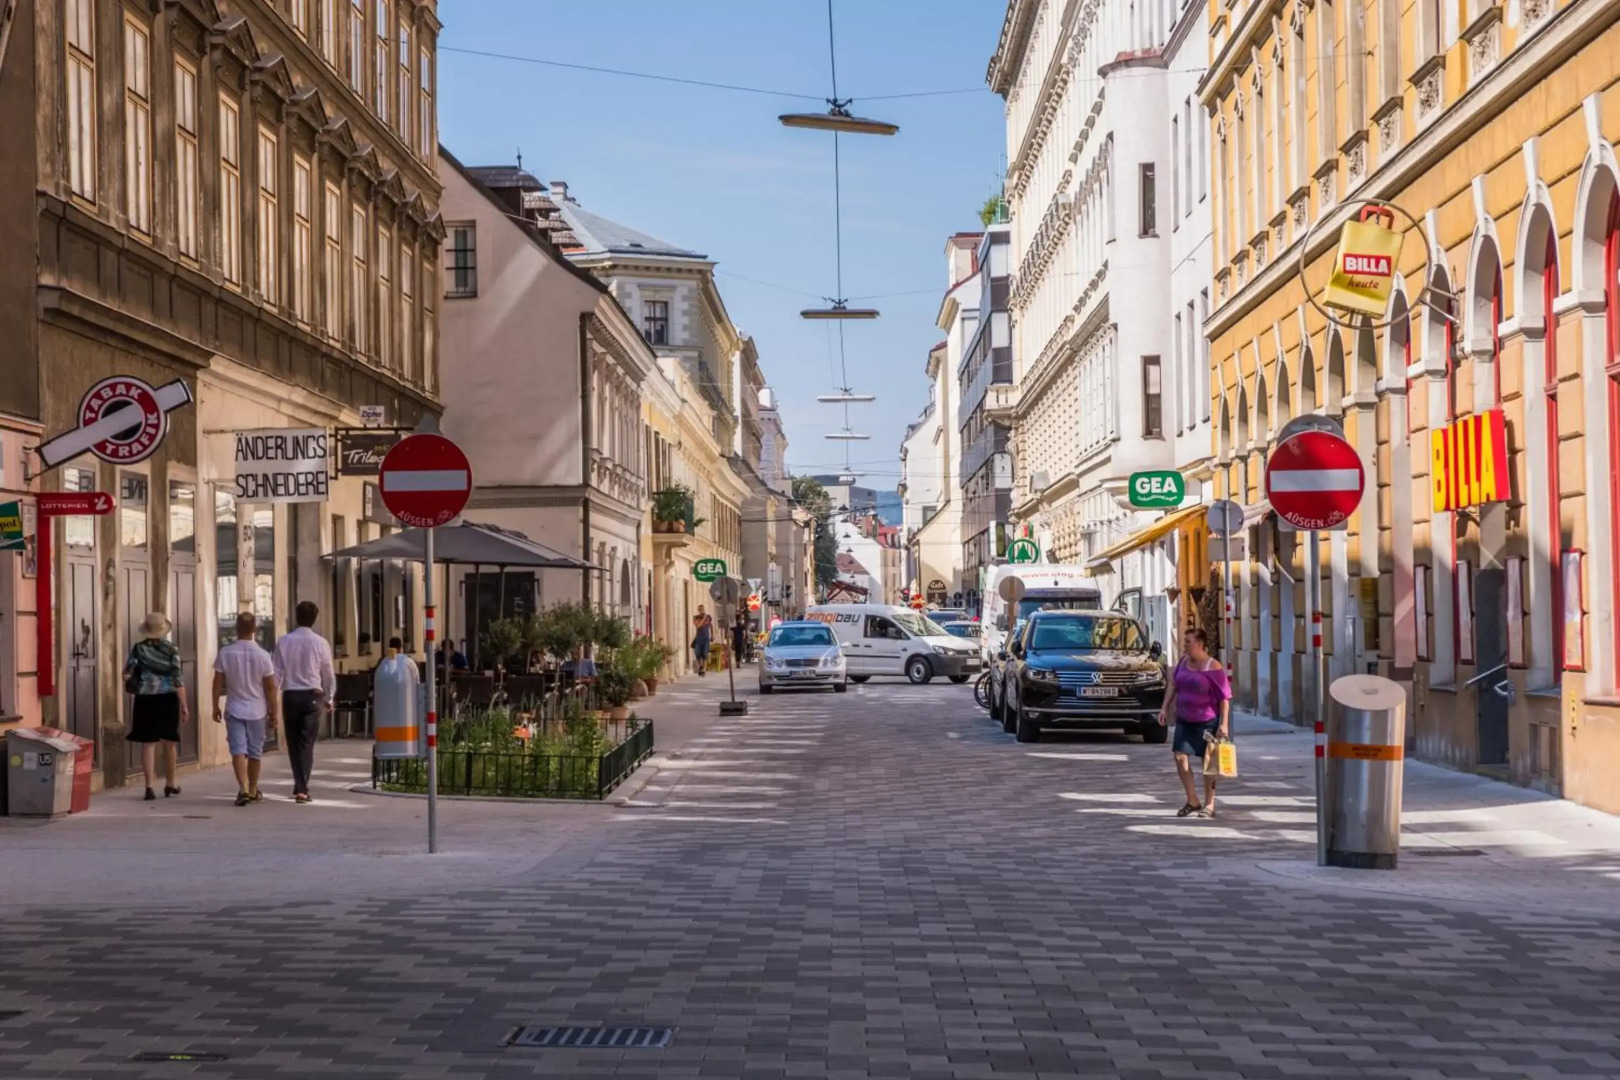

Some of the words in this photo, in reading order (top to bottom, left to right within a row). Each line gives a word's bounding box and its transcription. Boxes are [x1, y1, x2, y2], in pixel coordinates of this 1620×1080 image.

[1345, 256, 1389, 273] BILLA
[1347, 275, 1379, 289] heute
[85, 384, 142, 420] TABAK
[105, 412, 158, 457] TRAFIK
[235, 433, 327, 461] ÄNDERUNGS
[1431, 410, 1497, 513] BILLA
[235, 471, 329, 498] SCHNEIDEREI
[1135, 477, 1178, 494] GEA
[697, 563, 724, 574] GEA
